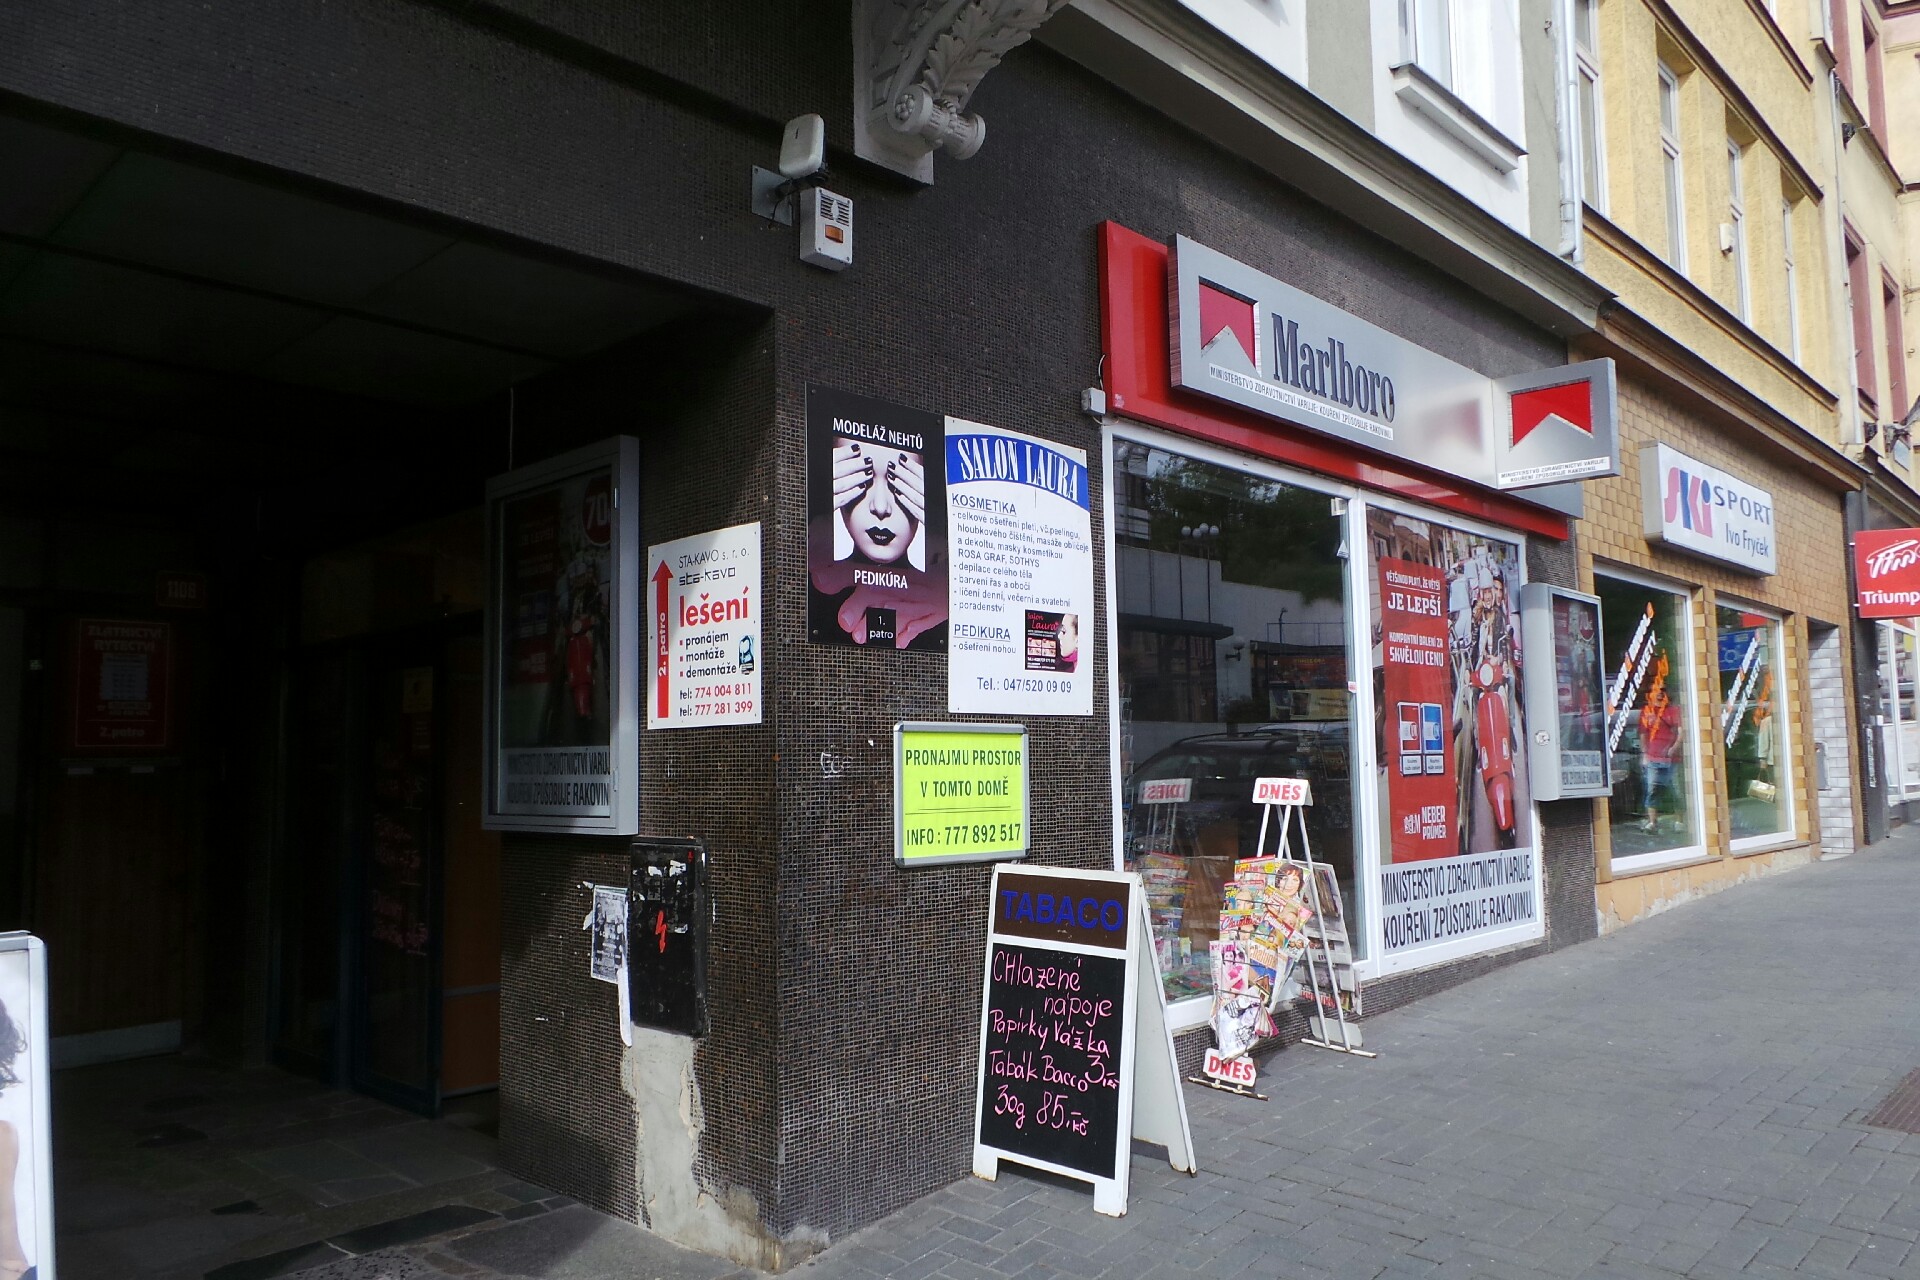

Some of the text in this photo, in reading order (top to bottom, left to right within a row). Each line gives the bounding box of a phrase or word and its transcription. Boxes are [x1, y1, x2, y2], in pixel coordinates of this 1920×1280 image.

[1271, 312, 1395, 423] Marlboro
[1210, 366, 1254, 391] MINISTERSTVO
[833, 417, 923, 450] MODELÁŽ NEHTŮ
[957, 437, 1078, 503] SALON LAURA
[951, 493, 1017, 515] KOSMETIKA
[1714, 485, 1771, 525] SPORT
[957, 511, 987, 523] celkové
[957, 523, 1007, 540] hloubkového
[1725, 523, 1769, 558] Ivo Fryček
[679, 547, 749, 568] STA-KAVO s. r. o.
[958, 548, 982, 560] ROSA
[1009, 555, 1040, 568] SOTHYS
[997, 543, 1021, 555] masky
[854, 568, 908, 589] PEDIKÚRA
[958, 562, 1033, 579] depilace celého těla
[959, 575, 988, 586] barvení
[989, 578, 1002, 588] řas
[679, 586, 749, 627] lešení
[1388, 592, 1442, 617] JE LEPŠÍ
[878, 616, 886, 626] 1.
[954, 623, 1011, 640] PEDIKURA
[658, 612, 669, 677] 2. patro
[685, 630, 729, 650] pronájem
[869, 628, 894, 641] patro
[1389, 631, 1419, 645] KOMPAKTNÍ
[686, 647, 725, 664] montáže
[993, 643, 1017, 654] nohou
[1389, 645, 1444, 667] SKVĚLOU CENU
[686, 662, 737, 679] demontáže
[679, 682, 751, 700] tel: 774 004 811
[977, 676, 1072, 693] Tel.: 047/520 09 09
[679, 701, 753, 717] tel: 777 281 399
[905, 749, 1021, 766] PRONAJMU PROSTOR
[920, 776, 1009, 798] V TOMTO DOMĚ
[1258, 783, 1301, 800] DNES
[1422, 805, 1446, 824] NEBER
[945, 825, 969, 845] 777
[972, 824, 996, 844] 892
[1000, 823, 1021, 842] 517
[1381, 852, 1532, 906] MINISTERSTVO ZDRAVOTNICTVÍ VARUJE:
[1001, 890, 1124, 932] TABACO
[1383, 904, 1431, 949] KOUŘENÍ
[1433, 898, 1488, 938] ZPŮSOBUJE
[1043, 992, 1113, 1028] nápoje
[990, 1008, 1110, 1059] Papírky Vážka
[988, 1050, 1089, 1093] Tabák Bacco
[1208, 1055, 1253, 1081] DNES
[994, 1084, 1026, 1130] 30g
